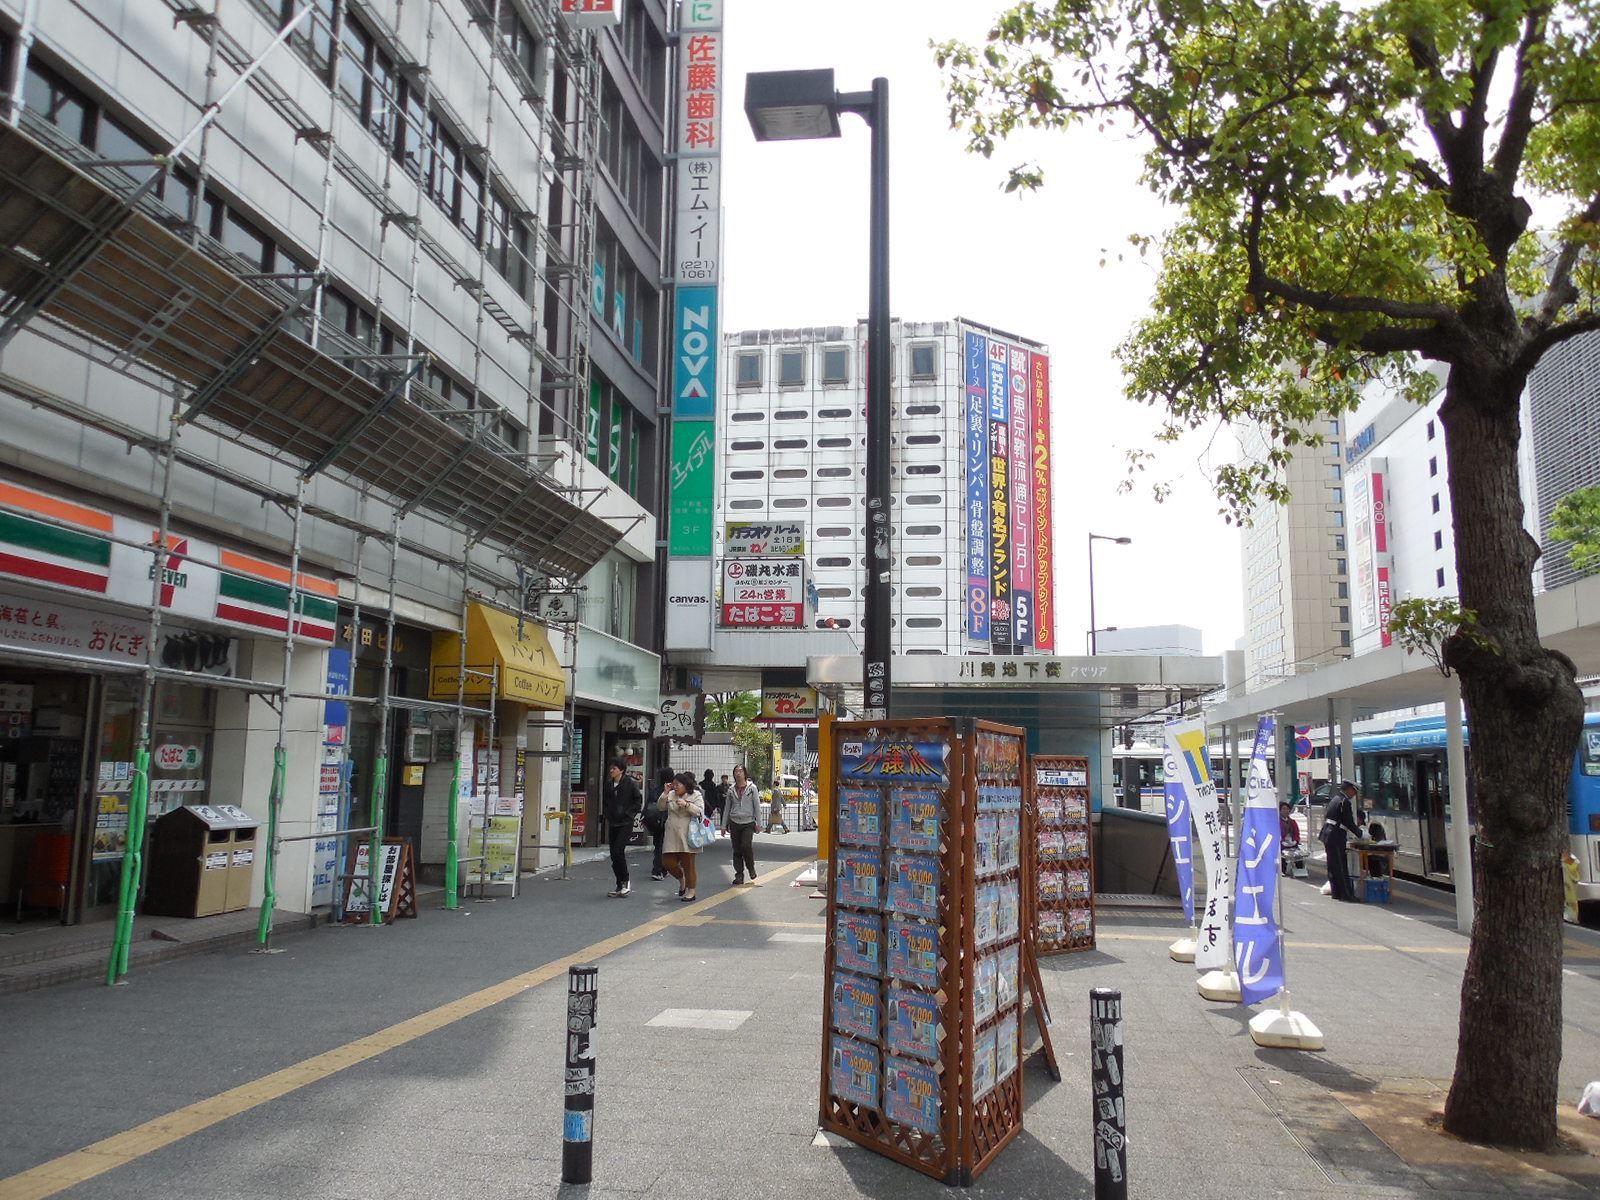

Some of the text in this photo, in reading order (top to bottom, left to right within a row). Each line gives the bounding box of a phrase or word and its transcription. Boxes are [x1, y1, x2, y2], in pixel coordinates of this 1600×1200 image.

[691, 0, 713, 22] に
[686, 35, 716, 148] 佐藤歯科
[688, 161, 713, 259] (株)エム・イー
[680, 260, 715, 270] (221)
[681, 270, 712, 279] 1061
[680, 306, 709, 397] NOVA
[990, 343, 1005, 361] 4F
[672, 430, 714, 490] エイブル
[969, 394, 985, 577] 足裏・リンパ・骨盤調整
[682, 525, 700, 535] 3F
[729, 524, 800, 539] カラオケ ルーム
[991, 456, 1008, 598] 世界の有名ブランド
[745, 563, 800, 577] 磯丸水産
[669, 594, 709, 604] canvas.
[739, 588, 786, 600] 24h営業
[729, 606, 796, 623] たばこ・酒
[970, 588, 986, 633] 8F
[1016, 596, 1028, 641] 5F
[959, 661, 1107, 677] 川崎地下街 アゼリア
[437, 676, 461, 686] Coffe
[514, 676, 532, 692] Coffee
[160, 749, 183, 762] たばこ
[1235, 828, 1273, 985] シエル
